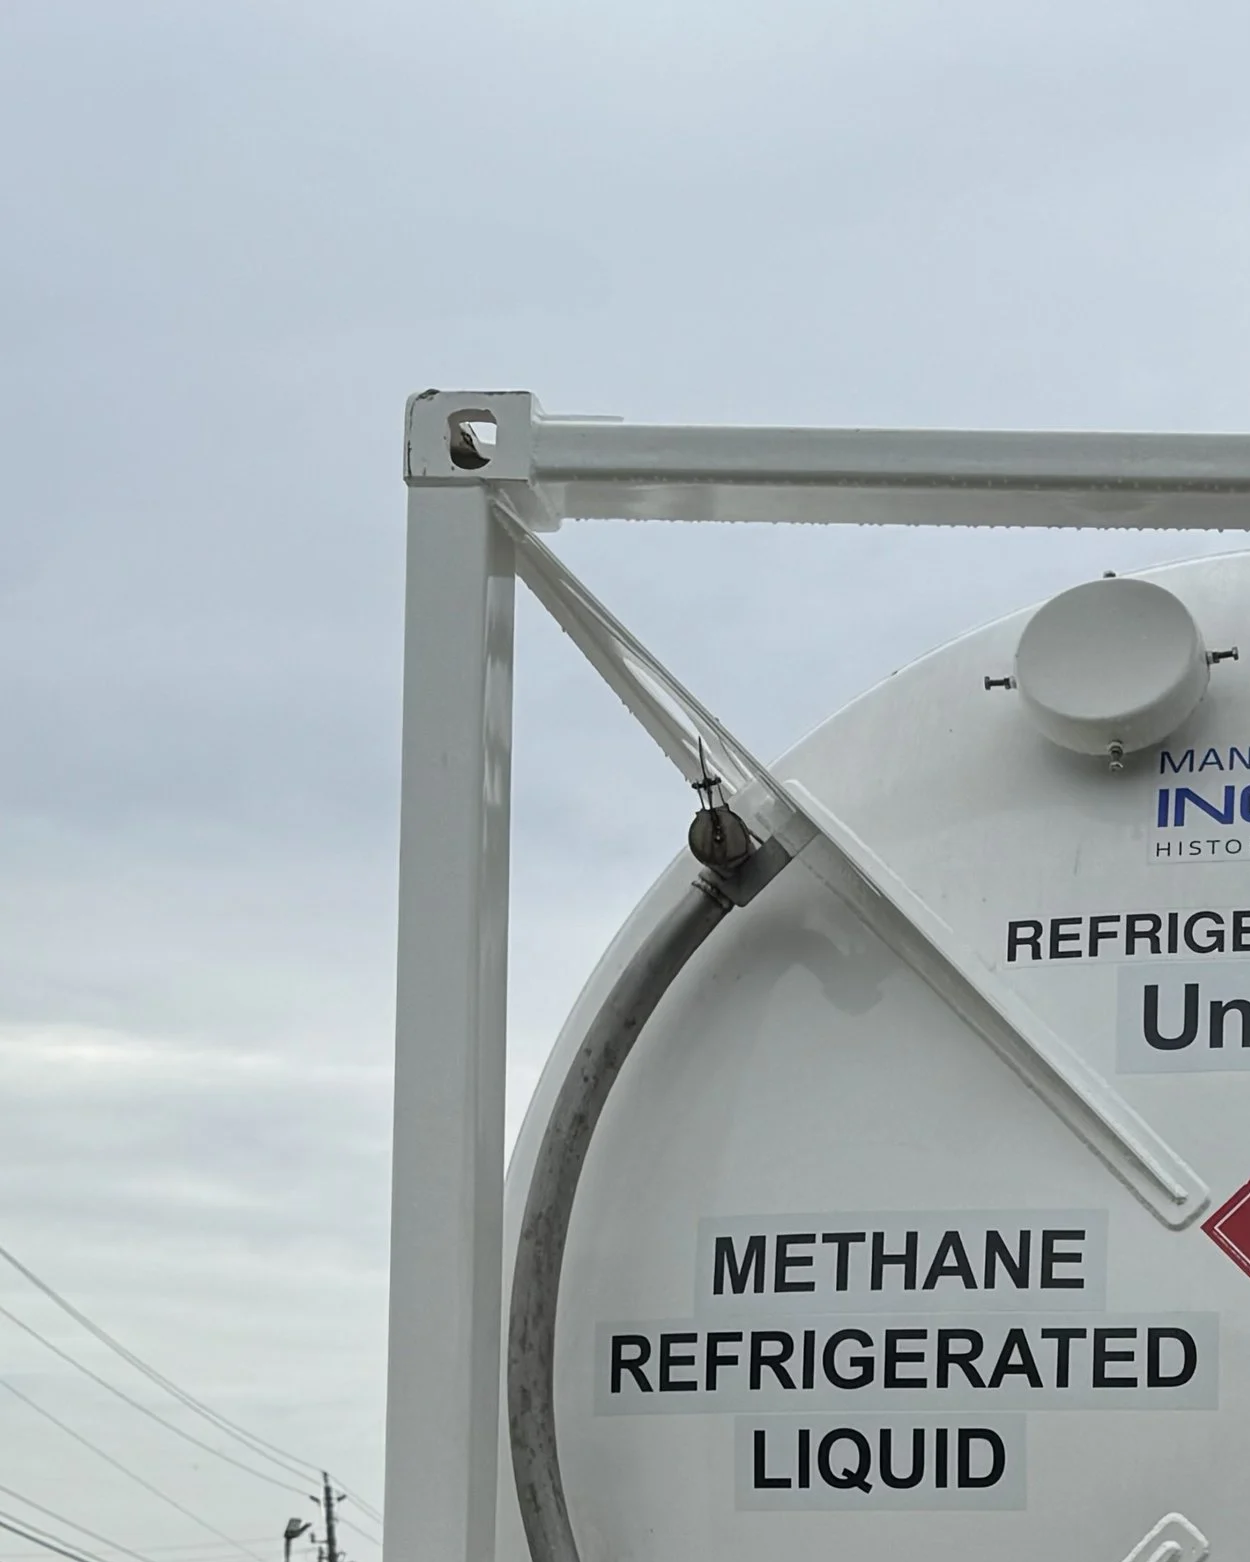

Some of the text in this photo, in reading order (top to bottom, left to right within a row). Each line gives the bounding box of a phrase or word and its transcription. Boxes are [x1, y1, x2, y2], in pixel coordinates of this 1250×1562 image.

[712, 1229, 1086, 1296] METHANE
[610, 1328, 1198, 1394] REFRIGERATED
[752, 1427, 1006, 1494] LIQUID
